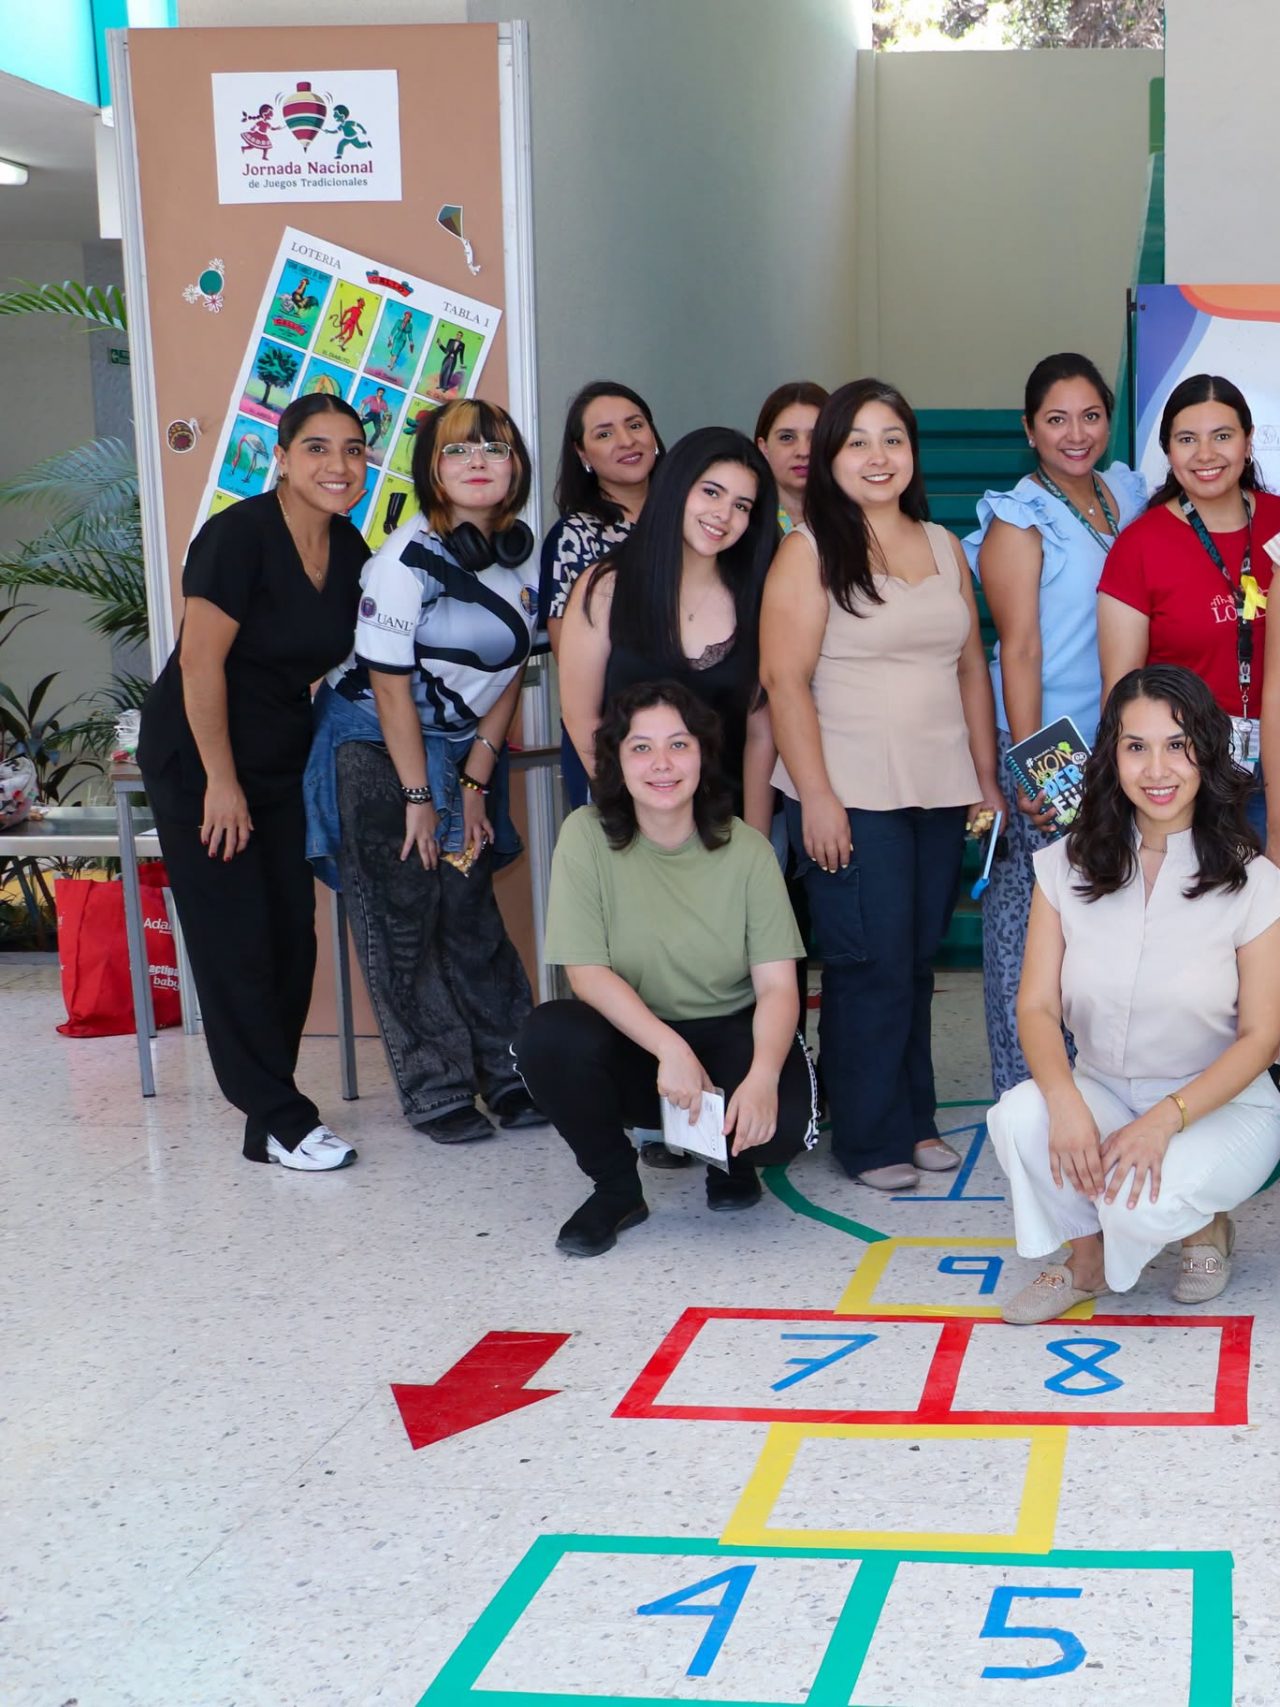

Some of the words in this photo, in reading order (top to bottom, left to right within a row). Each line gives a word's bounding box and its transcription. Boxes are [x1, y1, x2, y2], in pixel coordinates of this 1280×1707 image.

[242, 162, 302, 176] Jornada
[307, 160, 373, 174] Nacional
[248, 179, 260, 188] de
[263, 179, 298, 190] Juegos
[300, 177, 368, 188] Tradicionales
[291, 242, 341, 270] LOTERIA
[443, 301, 481, 324] TABLA
[377, 613, 411, 632] UANL
[937, 1255, 1005, 1295] 9
[770, 1333, 879, 1392] 7
[1044, 1338, 1124, 1396] 8
[636, 1564, 757, 1677] 4
[979, 1586, 1087, 1679] 5
